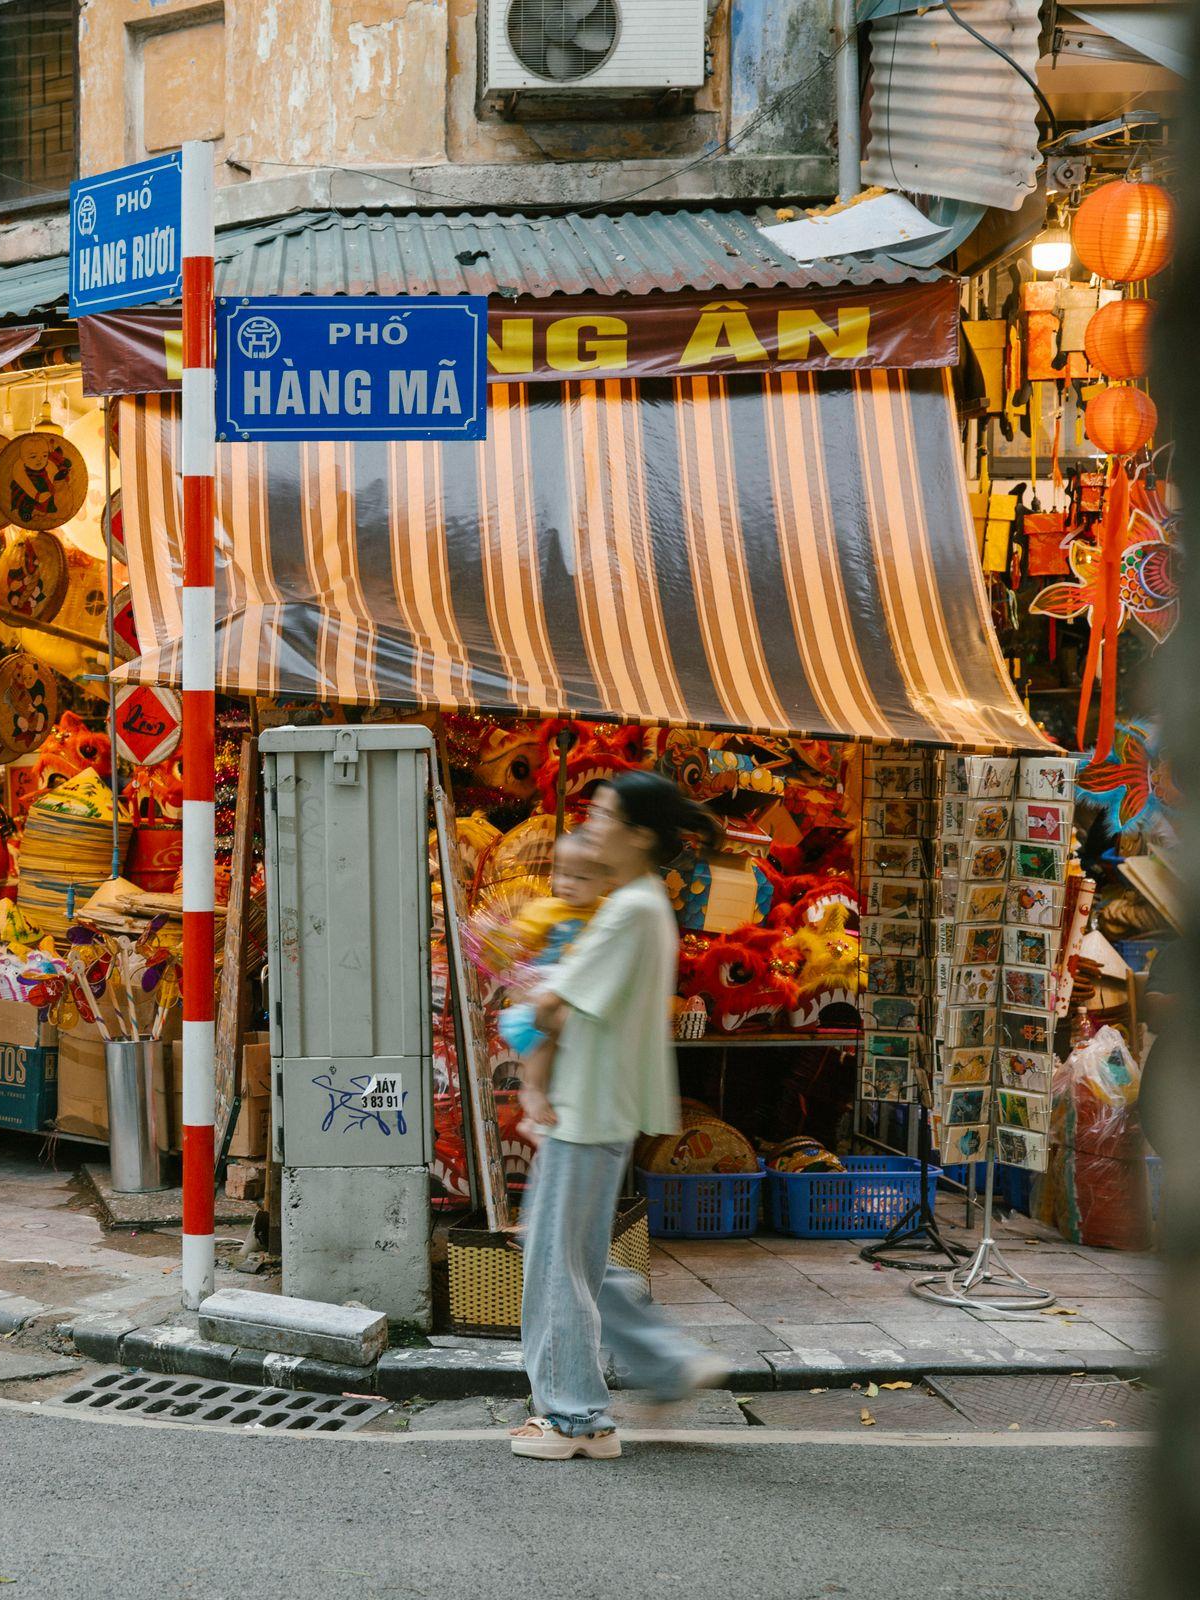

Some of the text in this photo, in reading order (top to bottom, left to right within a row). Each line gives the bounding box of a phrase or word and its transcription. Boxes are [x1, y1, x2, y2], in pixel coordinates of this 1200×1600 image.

[116, 175, 153, 215] PHỐ
[79, 225, 175, 291] HÀNG RƯƠI
[329, 311, 411, 345] PHỐ
[677, 300, 871, 366] ÂN
[243, 358, 463, 415] HÀNG MÃ
[371, 1096, 384, 1108] 83
[386, 1096, 398, 1108] 91
